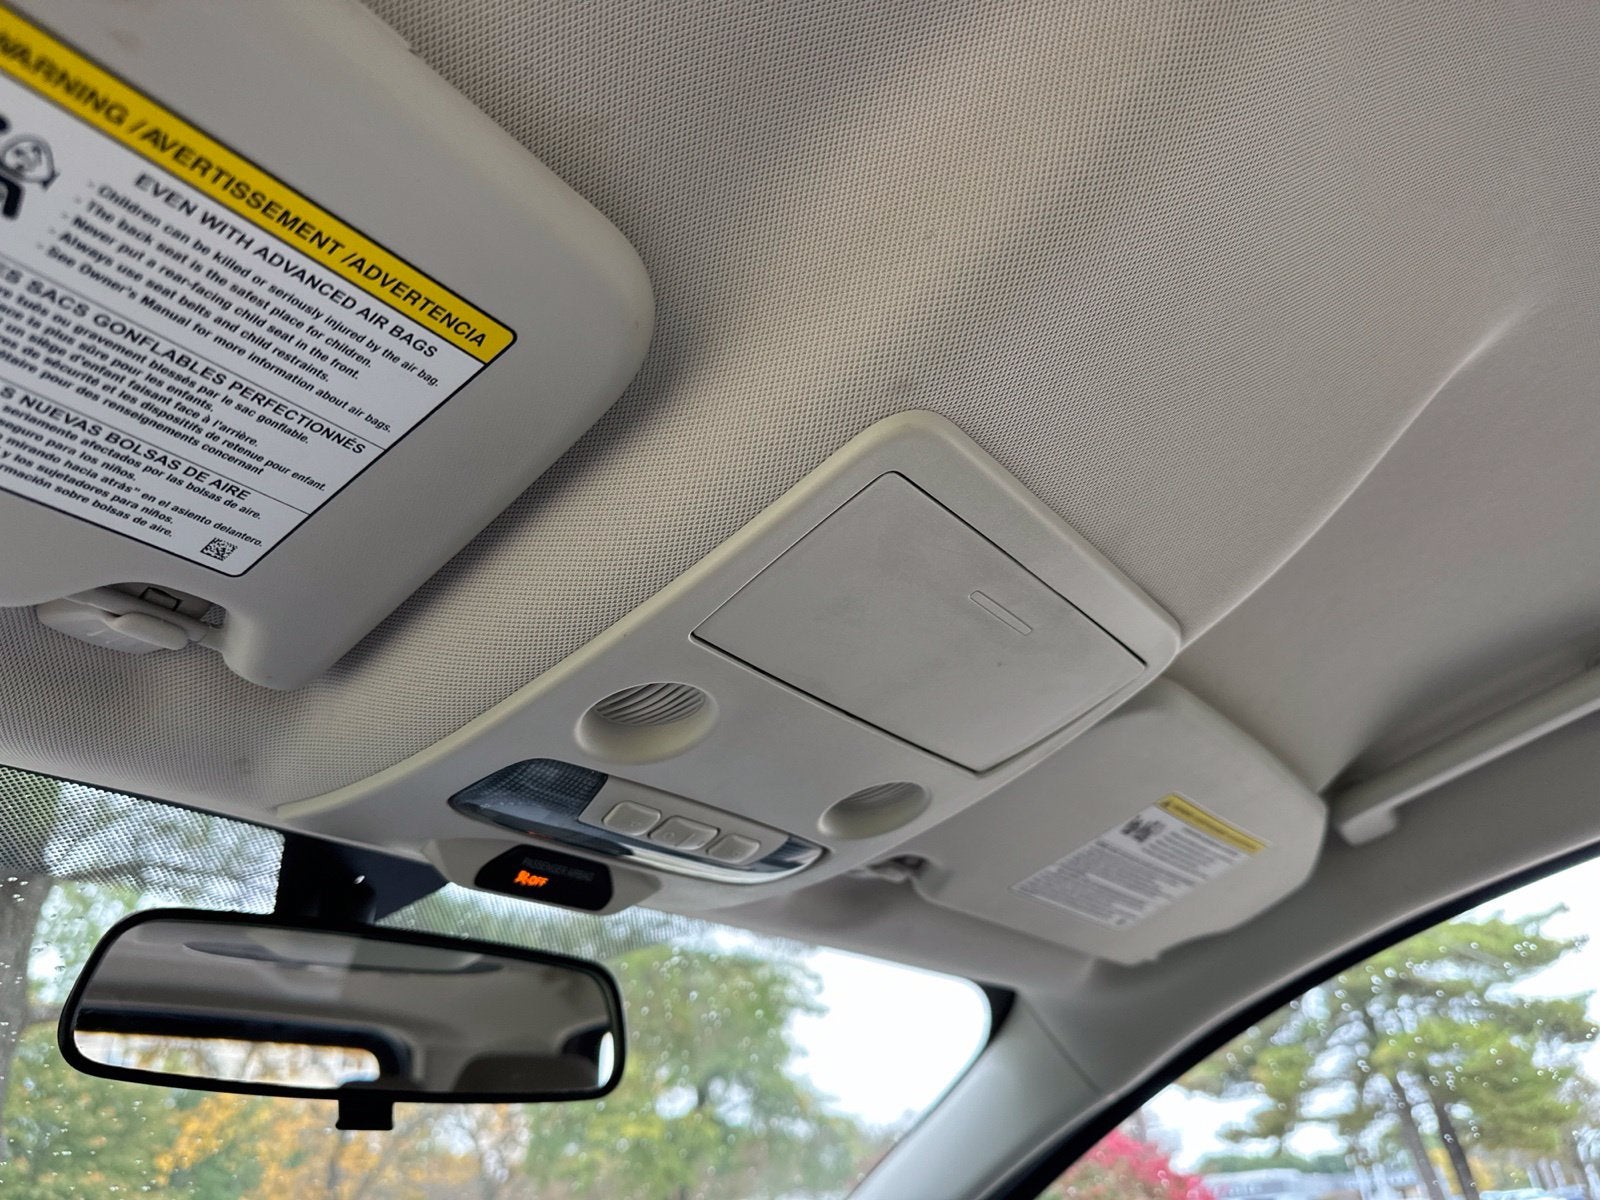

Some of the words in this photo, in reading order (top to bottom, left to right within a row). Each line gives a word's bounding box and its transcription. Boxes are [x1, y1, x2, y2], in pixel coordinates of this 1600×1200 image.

[59, 232, 114, 266] Always
[117, 264, 143, 281] use
[145, 279, 177, 299] seat
[178, 295, 211, 318] belts
[213, 316, 240, 333] and
[240, 330, 273, 350] child
[272, 347, 328, 382] restraints.
[73, 216, 115, 245] Never
[117, 244, 145, 261] put
[146, 259, 157, 268] a
[159, 266, 232, 311] rear-facing
[234, 307, 267, 327] child
[267, 325, 295, 343] seat
[295, 339, 308, 350] in
[309, 347, 329, 362] the
[330, 358, 359, 379] front.
[88, 201, 115, 222] The
[117, 219, 152, 245] back
[156, 243, 189, 264] seat
[189, 260, 203, 272] is
[205, 269, 228, 286] the
[230, 284, 270, 310] safest
[269, 307, 304, 328] place
[306, 325, 324, 339] for
[325, 338, 371, 368] children.
[98, 186, 161, 227] Children
[163, 225, 190, 243] can
[192, 239, 211, 254] be
[213, 251, 252, 278] killed
[252, 276, 266, 286] or
[268, 285, 324, 320] seriously
[324, 315, 367, 343] injured
[365, 339, 381, 353] by
[382, 349, 400, 363] the
[401, 361, 418, 372] air
[417, 369, 438, 387] bag.
[135, 173, 197, 216] EVEN
[200, 211, 254, 250] WITH
[253, 247, 357, 309] ADVANCED
[355, 307, 389, 330] AIR
[388, 325, 438, 357] BAGS
[22, 347, 40, 359] de
[102, 384, 117, 394] et
[118, 390, 138, 404] les
[140, 402, 203, 434] dispositifs
[205, 432, 220, 442] de
[221, 439, 264, 462] retenue
[263, 460, 291, 474] pour
[291, 472, 326, 491] enfant.
[26, 280, 89, 317] SACS
[93, 314, 227, 385] GONFLABLES
[228, 381, 366, 454] PERFECTIONNÉS
[39, 371, 72, 388] pour
[76, 387, 100, 401] des
[102, 399, 200, 446] renseignements
[201, 444, 264, 475] concernant
[43, 326, 75, 345] plus
[78, 342, 109, 361] sûre
[110, 358, 142, 376] pour
[144, 373, 165, 387] les
[166, 385, 213, 412] enfants.
[52, 314, 71, 327] ou
[73, 325, 147, 364] gravement
[148, 360, 197, 388] blessés
[196, 385, 220, 399] par
[221, 395, 233, 406] le
[234, 403, 256, 417] sac
[256, 414, 308, 444] gonflable.
[127, 380, 173, 405] faisant
[173, 402, 200, 419] face
[201, 415, 211, 424] à
[140, 295, 192, 327] Manual
[192, 323, 211, 337] for
[213, 336, 246, 355] more
[247, 352, 315, 392] information
[315, 389, 349, 409] about
[348, 406, 365, 417] air
[364, 414, 390, 433] bags.
[3, 405, 78, 441] seriamente
[80, 439, 142, 468] afectados
[142, 465, 165, 477] por
[166, 473, 184, 486] las
[185, 482, 222, 502] bolsas
[223, 499, 238, 508] de
[238, 506, 260, 520] aire.
[6, 437, 61, 463] mirando
[63, 460, 98, 479] hacia
[141, 493, 156, 503] en
[158, 500, 171, 508] el
[171, 505, 212, 525] asiento
[213, 523, 262, 547] delantero.
[13, 454, 34, 467] los
[36, 465, 110, 497] sujetadores
[110, 495, 139, 509] para
[140, 506, 173, 524] niños.
[19, 395, 102, 436] NUEVAS
[105, 432, 182, 470] BOLSAS
[182, 466, 210, 483] DE
[208, 479, 251, 501] AIRE
[45, 439, 77, 455] para
[79, 451, 99, 464] los
[101, 462, 135, 481] niños.
[54, 486, 90, 503] sobre
[92, 499, 131, 519] bolsas
[132, 517, 148, 526] de
[149, 524, 172, 537] aire.
